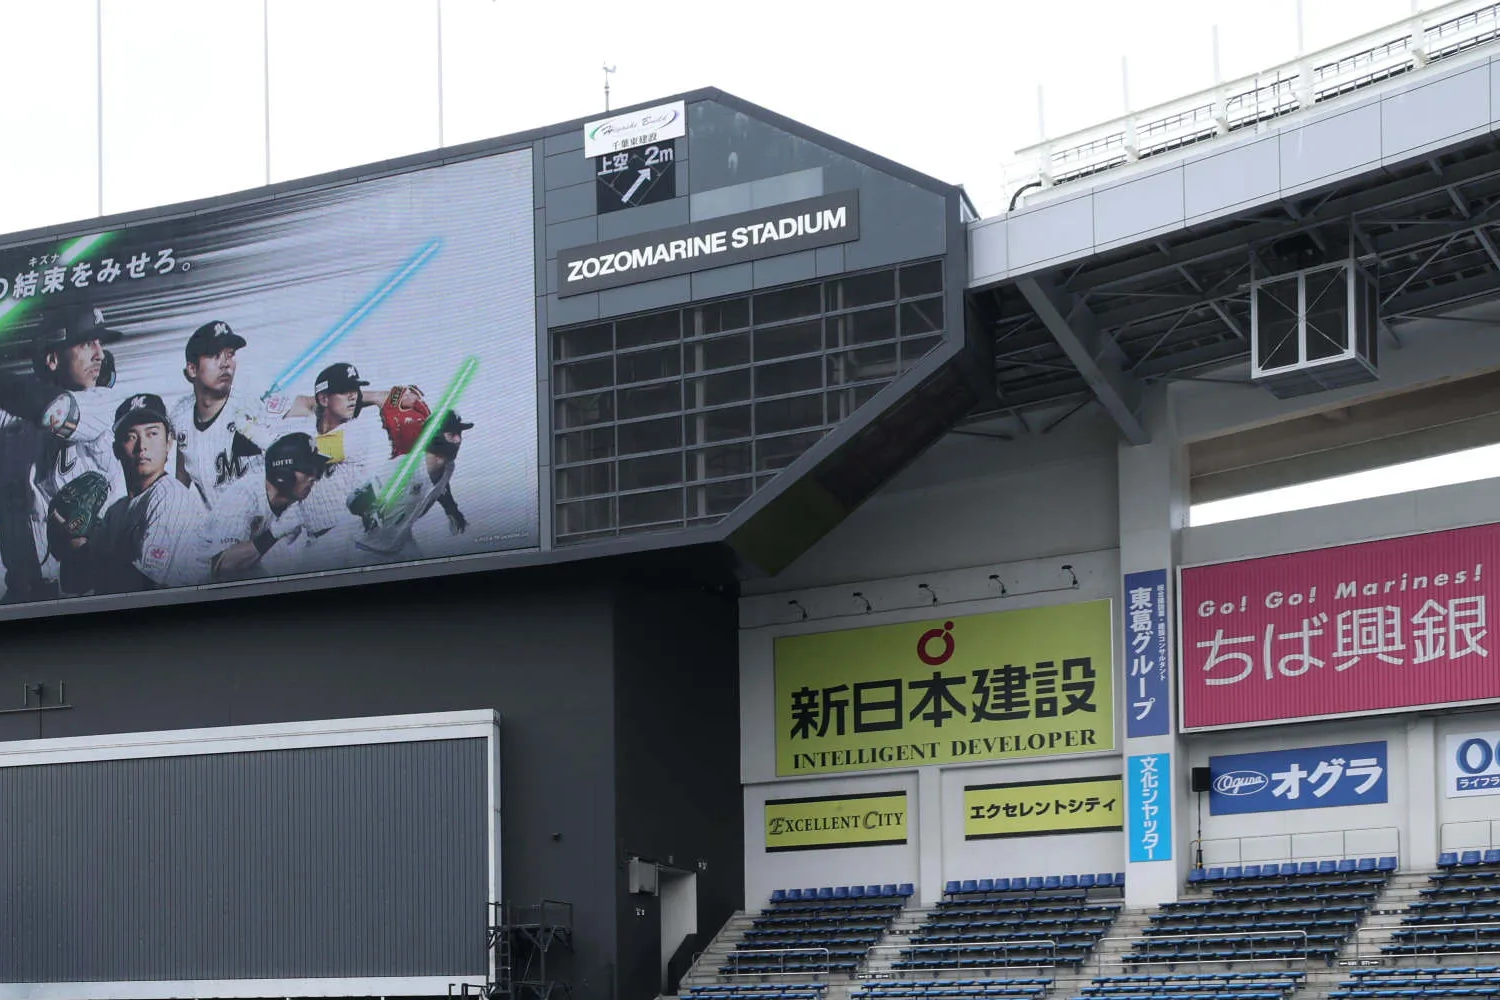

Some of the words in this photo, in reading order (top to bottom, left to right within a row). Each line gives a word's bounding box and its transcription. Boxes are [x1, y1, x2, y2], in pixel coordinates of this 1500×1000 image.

[597, 152, 629, 175] 上空
[644, 145, 674, 166] 2m
[28, 254, 60, 267] キズナ
[567, 232, 727, 282] ZOZOMARINE
[731, 206, 847, 248] STADIUM
[1198, 595, 1248, 617] Go!
[1265, 587, 1317, 609] Go!
[1335, 564, 1484, 600] Marines!
[1129, 587, 1156, 721] 東葛グループ
[1197, 595, 1489, 687] ちば興銀
[790, 656, 1097, 740] 新日本建設
[792, 742, 941, 769] INTELLIGENT
[950, 729, 1097, 757] DEVELOPER
[1272, 757, 1384, 800] オグラ
[769, 814, 861, 836] EXCELLENT
[862, 811, 904, 829] CITY
[970, 797, 1117, 820] エクセレントシティ
